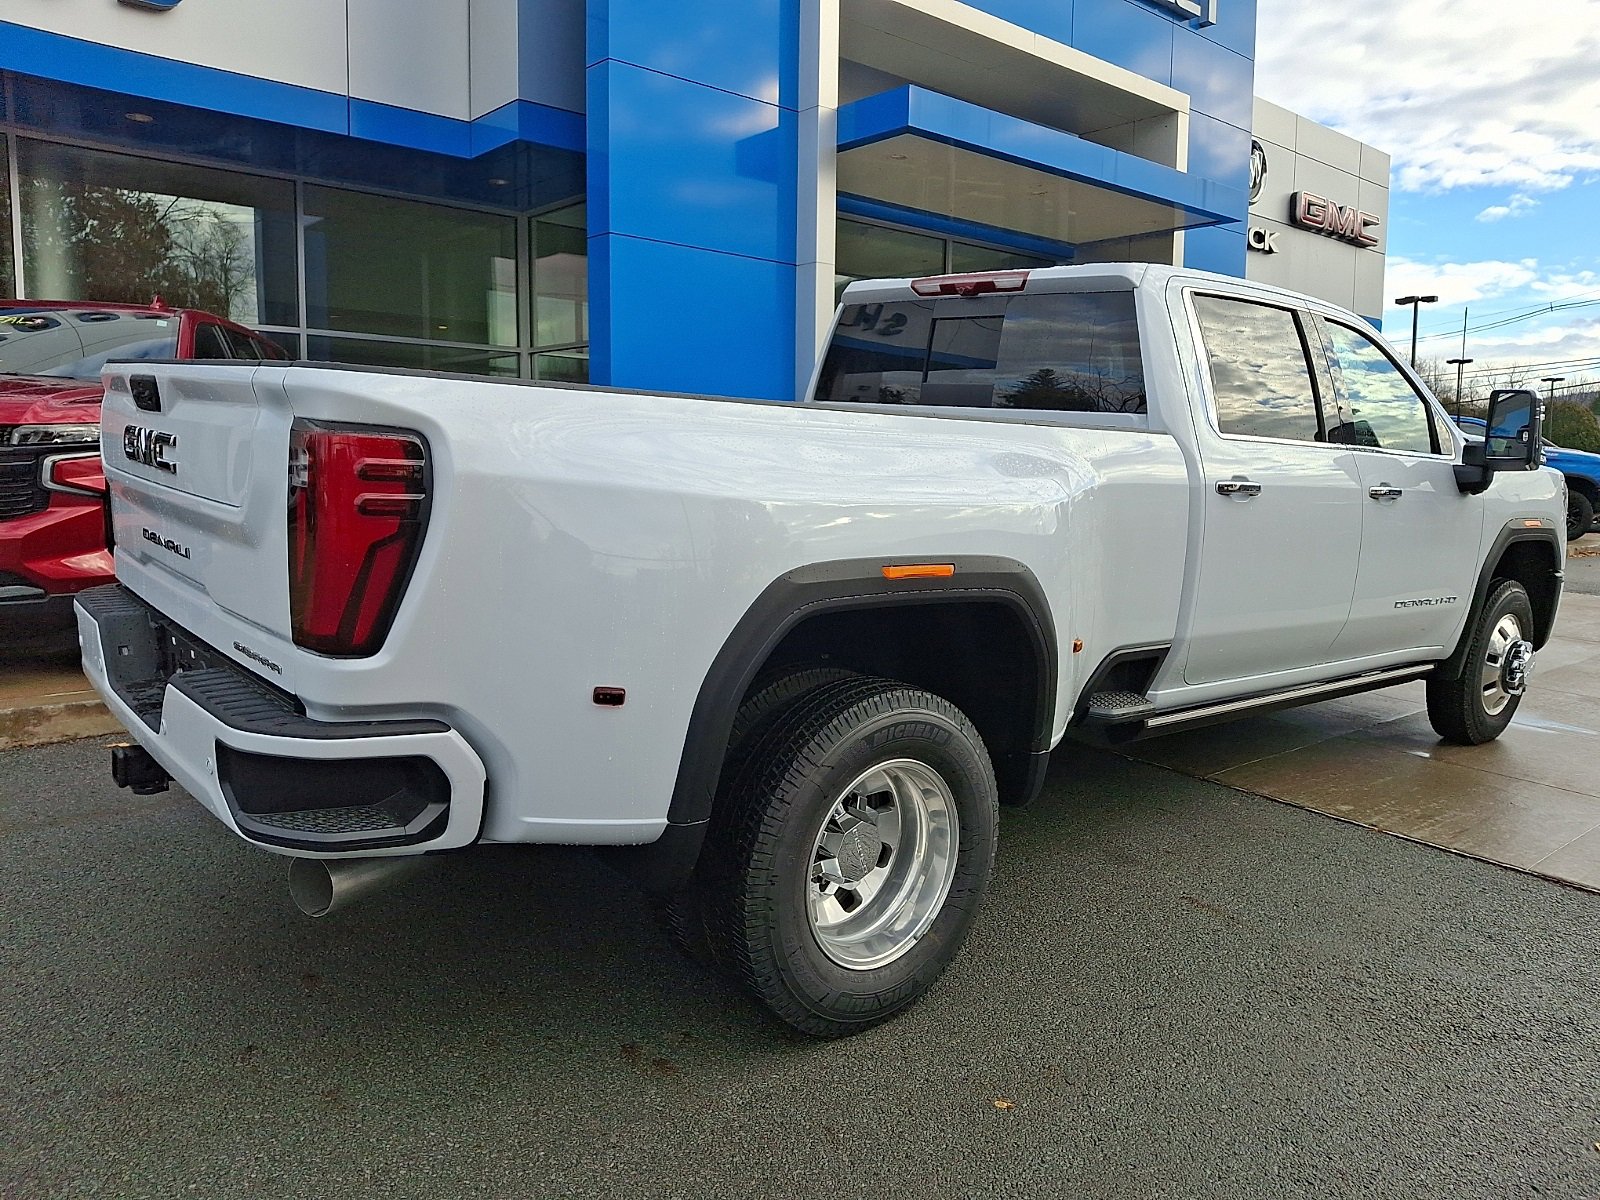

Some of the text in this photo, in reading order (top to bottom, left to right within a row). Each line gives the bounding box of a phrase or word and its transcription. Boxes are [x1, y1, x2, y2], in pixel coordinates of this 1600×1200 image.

[1299, 191, 1380, 246] GMC
[123, 424, 177, 475] GMC
[142, 527, 191, 560] DENALI
[1393, 597, 1439, 609] DENALI
[873, 723, 951, 747] MICHELIN
